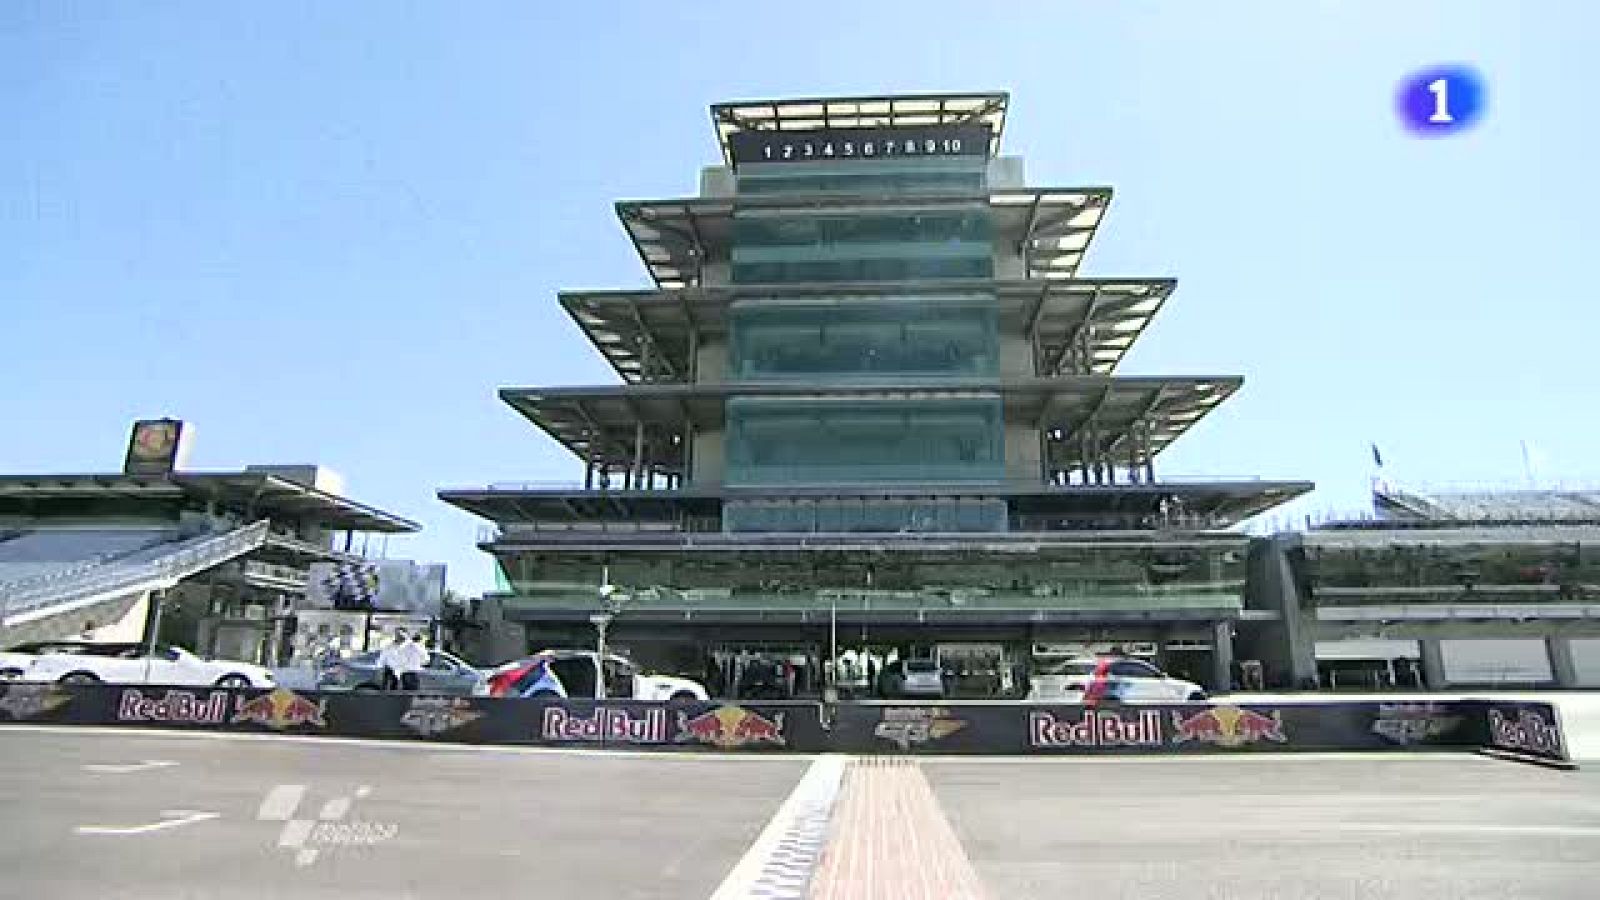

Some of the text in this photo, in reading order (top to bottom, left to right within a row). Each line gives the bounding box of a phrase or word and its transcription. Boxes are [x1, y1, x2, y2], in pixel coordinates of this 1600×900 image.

[824, 142, 833, 155] 4
[943, 139, 961, 153] 10
[119, 689, 228, 723] Red Bull
[542, 707, 666, 743] Red Bull
[1030, 709, 1161, 746] Red Bull
